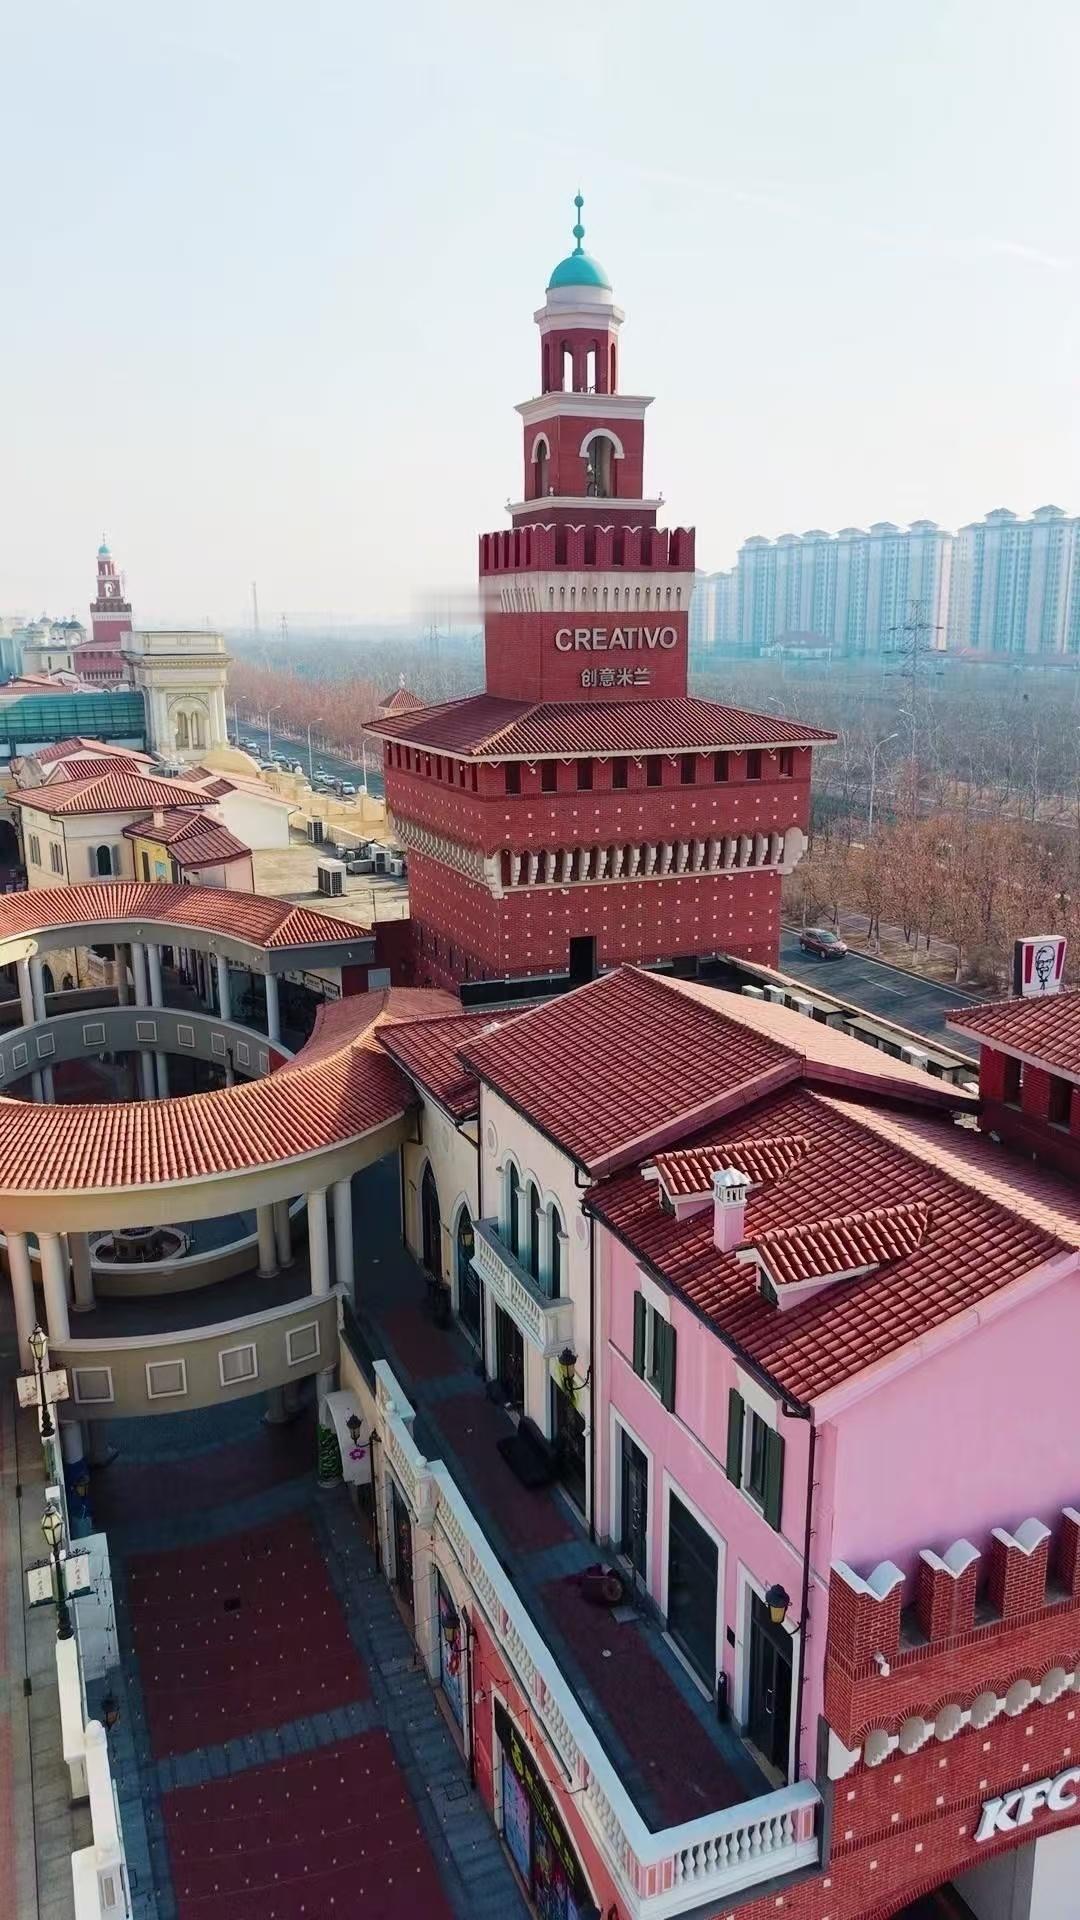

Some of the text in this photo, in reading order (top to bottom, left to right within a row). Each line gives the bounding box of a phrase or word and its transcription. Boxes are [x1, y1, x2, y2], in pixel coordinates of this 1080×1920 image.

[555, 626, 678, 651] CREATIVO
[581, 667, 651, 688] 创意米兰
[974, 1766, 1080, 1842] KFC
